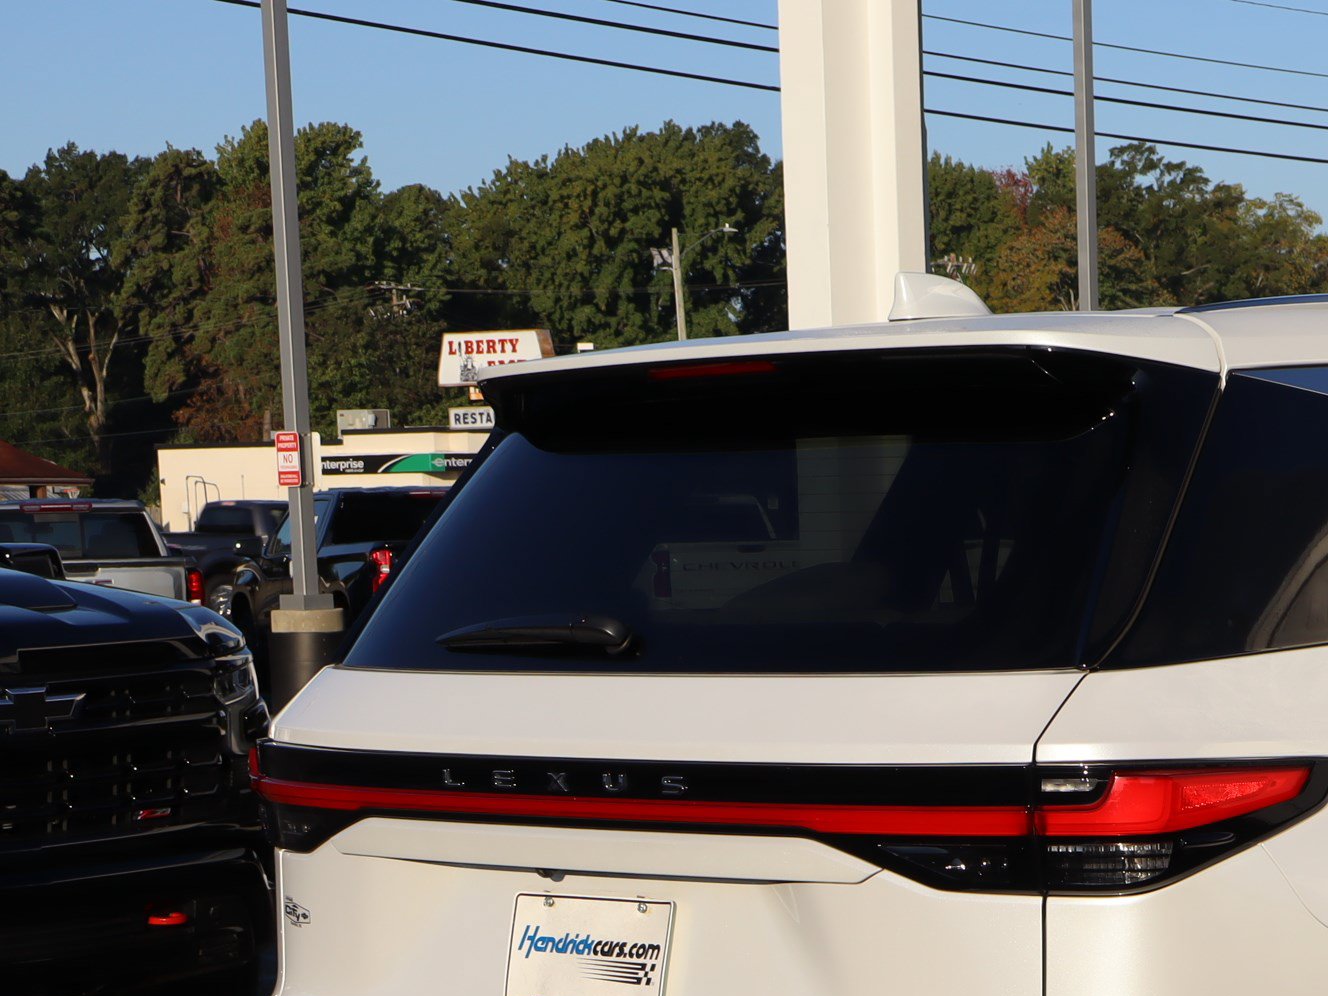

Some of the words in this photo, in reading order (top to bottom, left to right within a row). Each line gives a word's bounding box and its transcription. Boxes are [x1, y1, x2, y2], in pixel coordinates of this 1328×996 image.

[448, 338, 519, 356] LIBERTY
[282, 453, 294, 464] NO
[442, 768, 689, 795] LEXUS
[518, 924, 661, 961] Hendrickcars.com
